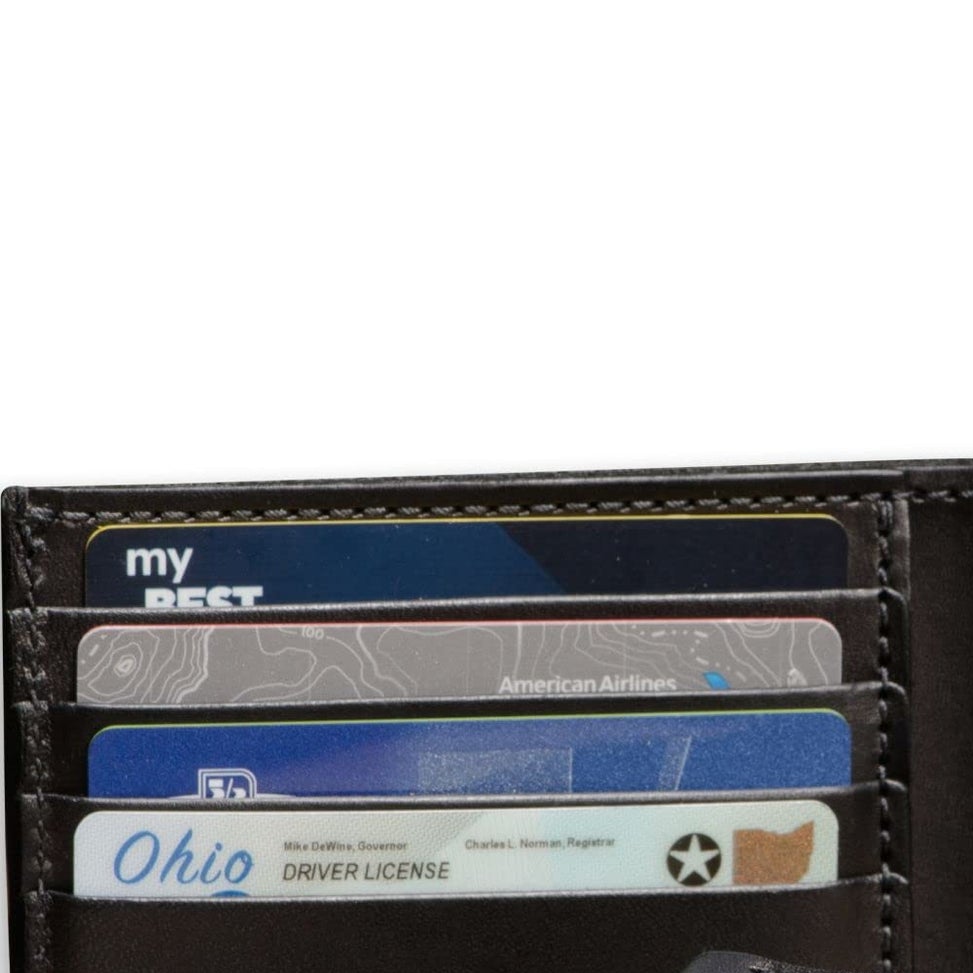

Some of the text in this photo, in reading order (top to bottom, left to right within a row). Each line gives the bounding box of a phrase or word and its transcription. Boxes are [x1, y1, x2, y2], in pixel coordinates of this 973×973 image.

[126, 547, 194, 584] my
[144, 585, 264, 608] BEST
[301, 626, 325, 640] 100
[498, 674, 678, 694] American Airlines
[283, 840, 408, 853] Mike DeWine, Governor
[464, 838, 506, 850] Charles
[519, 838, 566, 850] Norman,
[567, 837, 616, 849] Registrar
[113, 828, 255, 884] Ohio
[282, 861, 450, 881] DRIVER LICENSE
